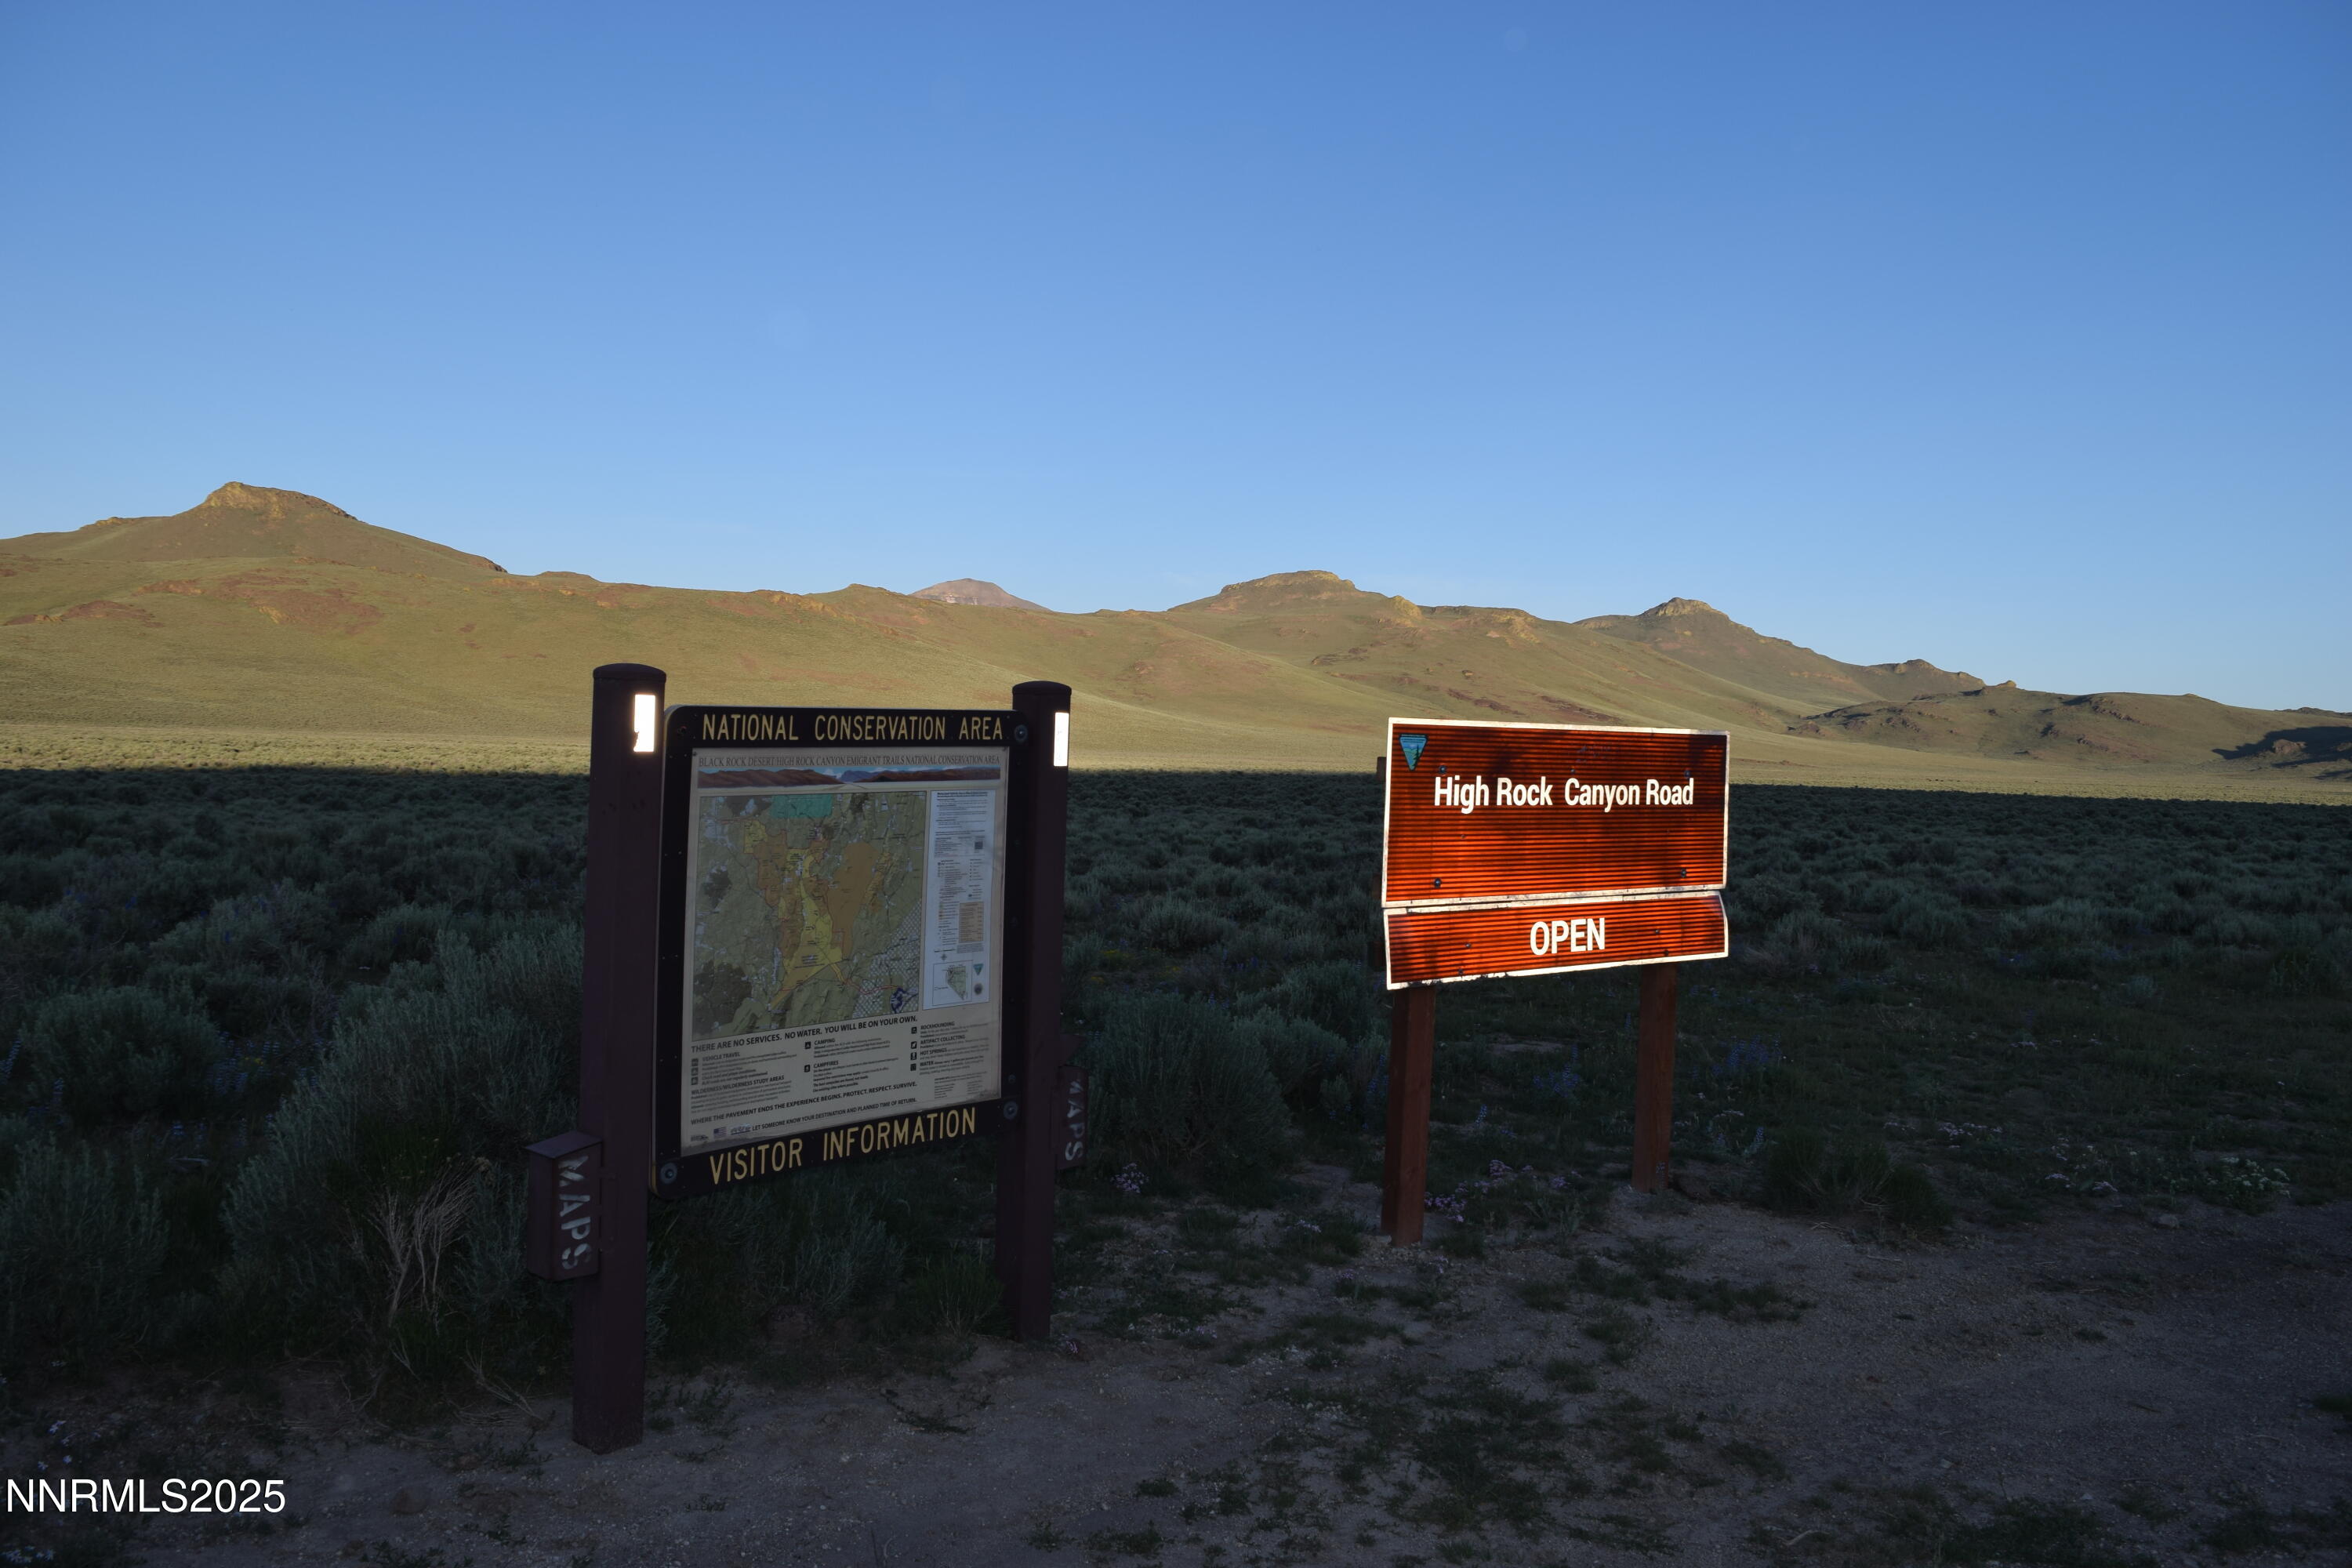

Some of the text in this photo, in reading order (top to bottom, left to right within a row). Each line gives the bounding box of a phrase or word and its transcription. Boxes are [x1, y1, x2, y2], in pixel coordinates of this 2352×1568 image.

[702, 713, 1003, 740] NATIONAL CONSERVATION AREA
[699, 757, 725, 767] BLACK
[726, 757, 747, 767] ROCK
[796, 757, 815, 766] ROCK
[816, 756, 844, 766] CANYON
[847, 755, 881, 765] EMIGRANT
[882, 755, 904, 765] TRAILS
[906, 755, 936, 765] NATIONAL
[938, 755, 983, 765] CONSERVATION
[984, 755, 1000, 764] AREA
[1434, 775, 1694, 814] High Rock Canyon Road
[1530, 917, 1606, 956] OPEN
[691, 1044, 716, 1053] THERE
[733, 1039, 745, 1047] NO
[746, 1033, 782, 1044] SERVICES.
[797, 1029, 822, 1037] WATER.
[880, 1018, 898, 1026] YOUR
[814, 1060, 838, 1069] CAMPFIRES
[691, 1116, 712, 1126] WHERE
[725, 1109, 757, 1119] PAVEMENT
[786, 1098, 819, 1107] EXPERIENCE
[762, 1120, 785, 1130] SOMEONE
[815, 1109, 846, 1120] DESTINATION
[858, 1104, 879, 1112] PLANNED
[1065, 1079, 1085, 1161] MAPS
[710, 1107, 976, 1185] VISITOR INFORMATION
[558, 1155, 592, 1270] MAPS
